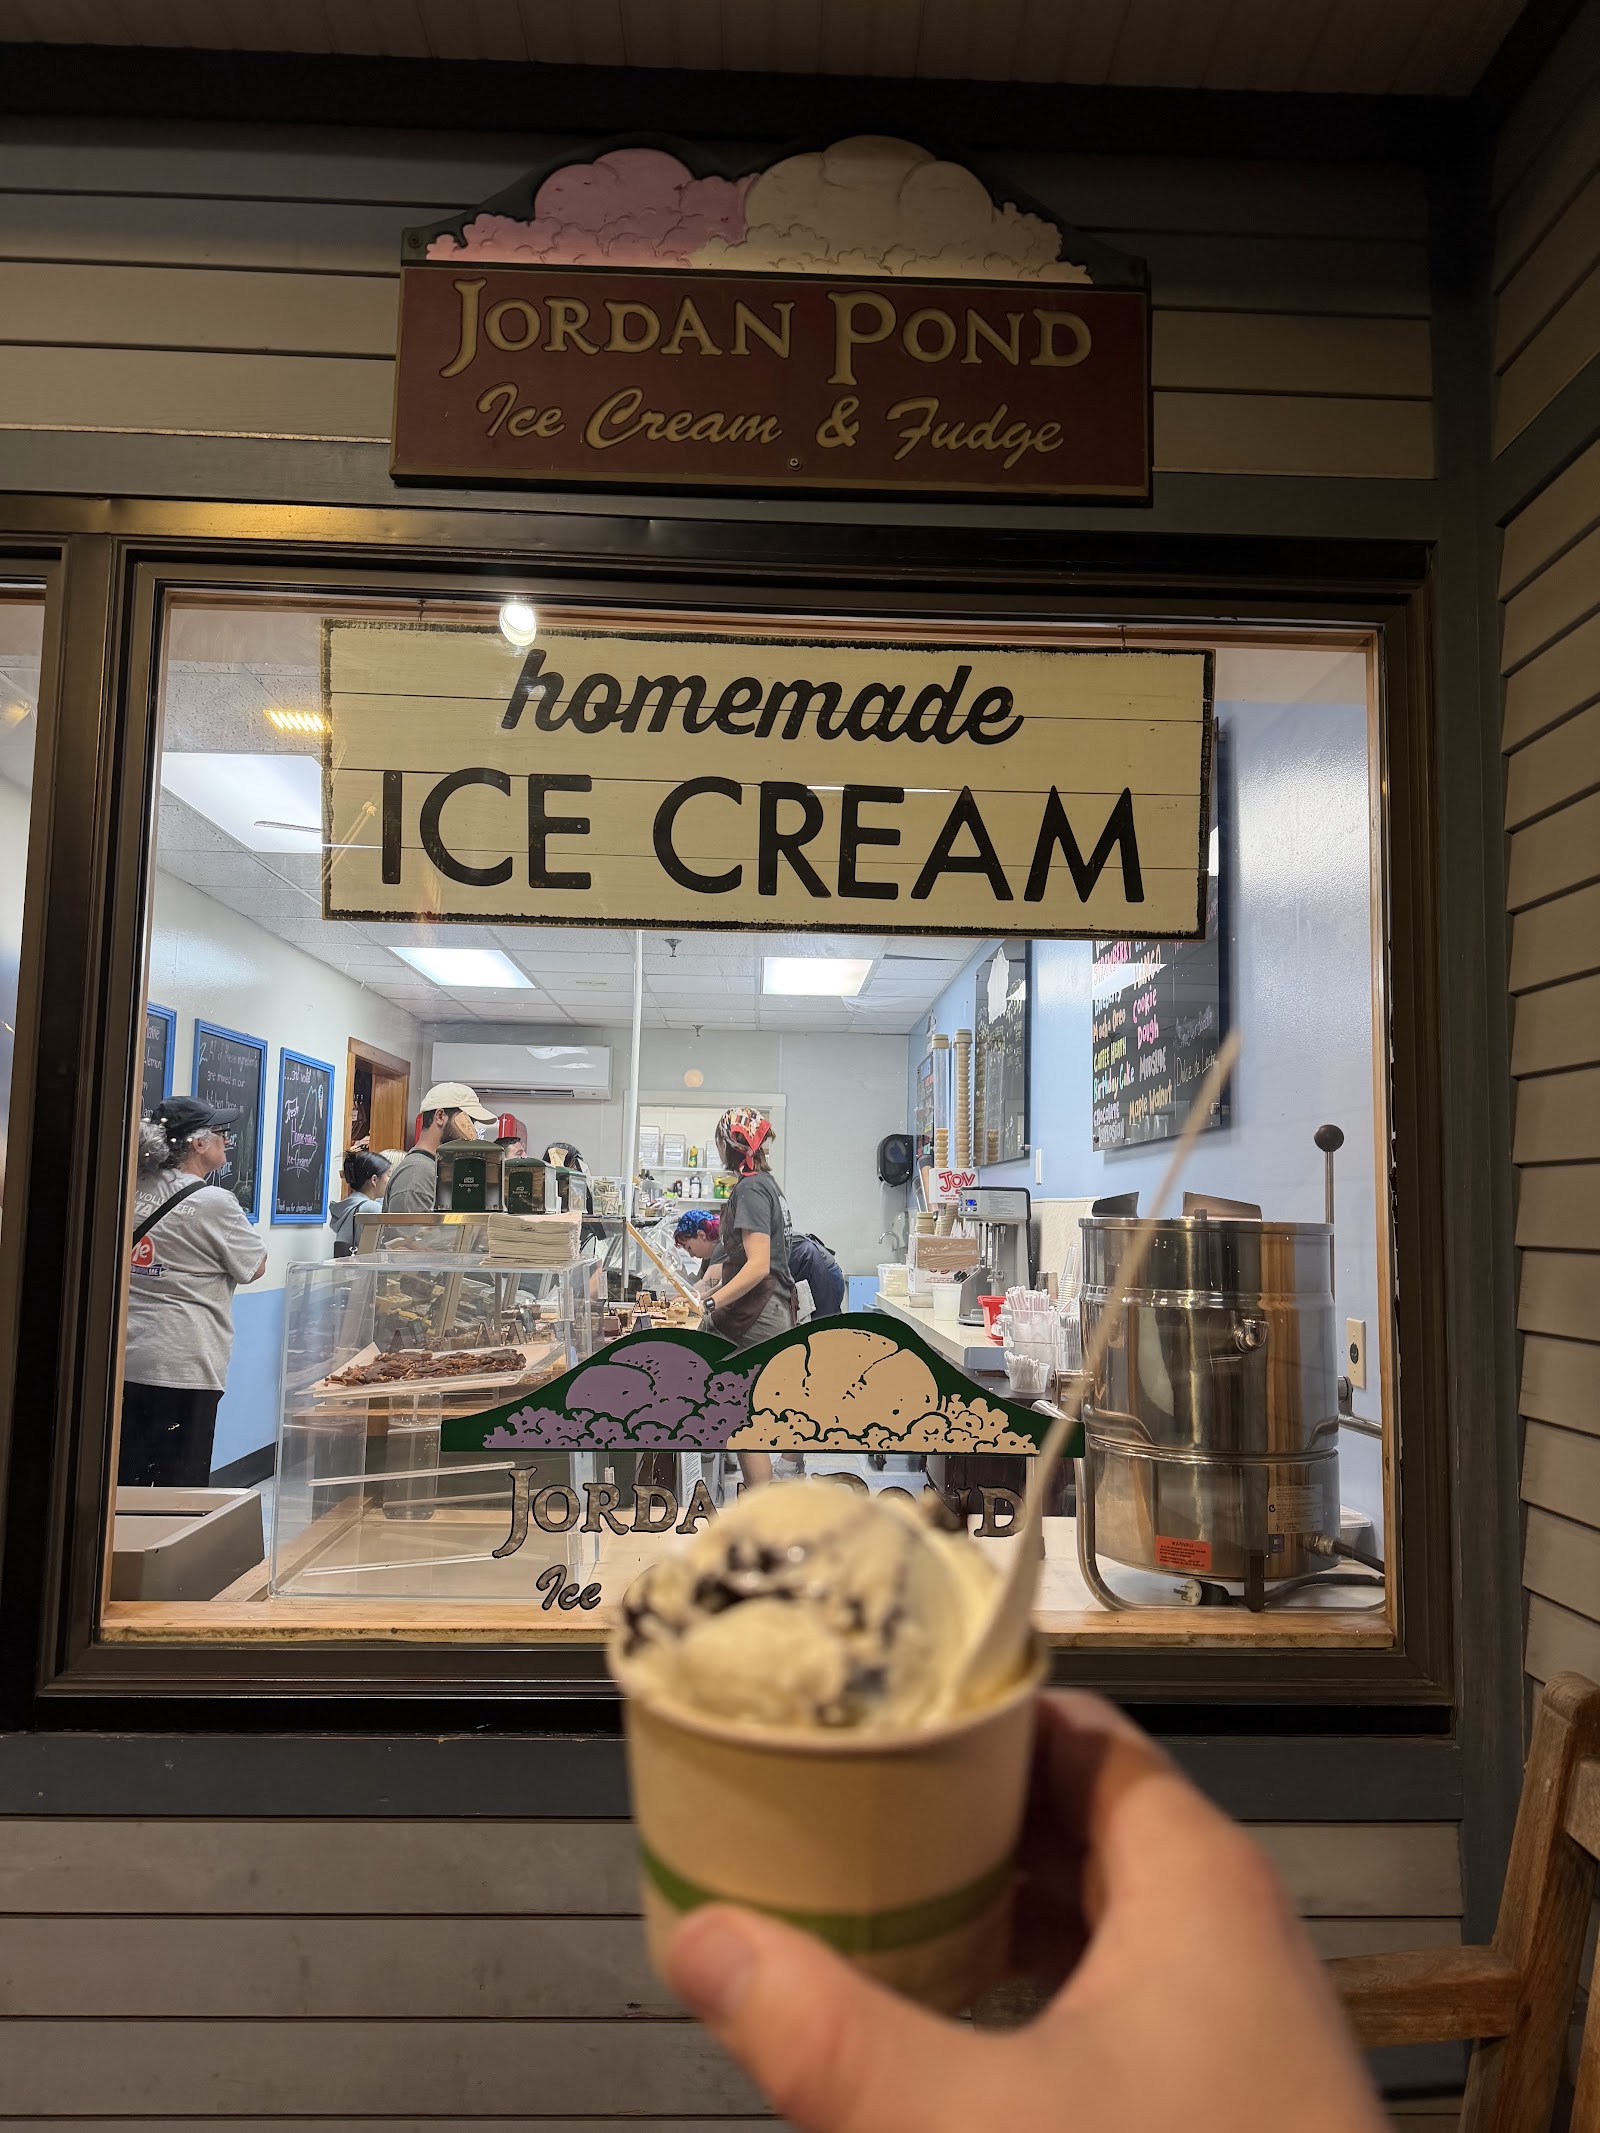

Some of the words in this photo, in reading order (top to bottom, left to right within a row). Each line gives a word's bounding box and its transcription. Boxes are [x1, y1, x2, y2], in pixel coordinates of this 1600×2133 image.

[439, 277, 796, 379] JORDAN
[826, 290, 1092, 386] POND
[476, 382, 565, 438] Ice
[585, 386, 782, 450] Cream
[816, 394, 861, 449] &
[885, 396, 1064, 470] Fudge
[500, 648, 1025, 747] homemade
[382, 767, 594, 890] ICE
[652, 776, 1146, 903] CREAM
[1132, 985, 1157, 1024] Cookie
[492, 1467, 745, 1559] JORDA
[536, 1564, 601, 1611] Ice
